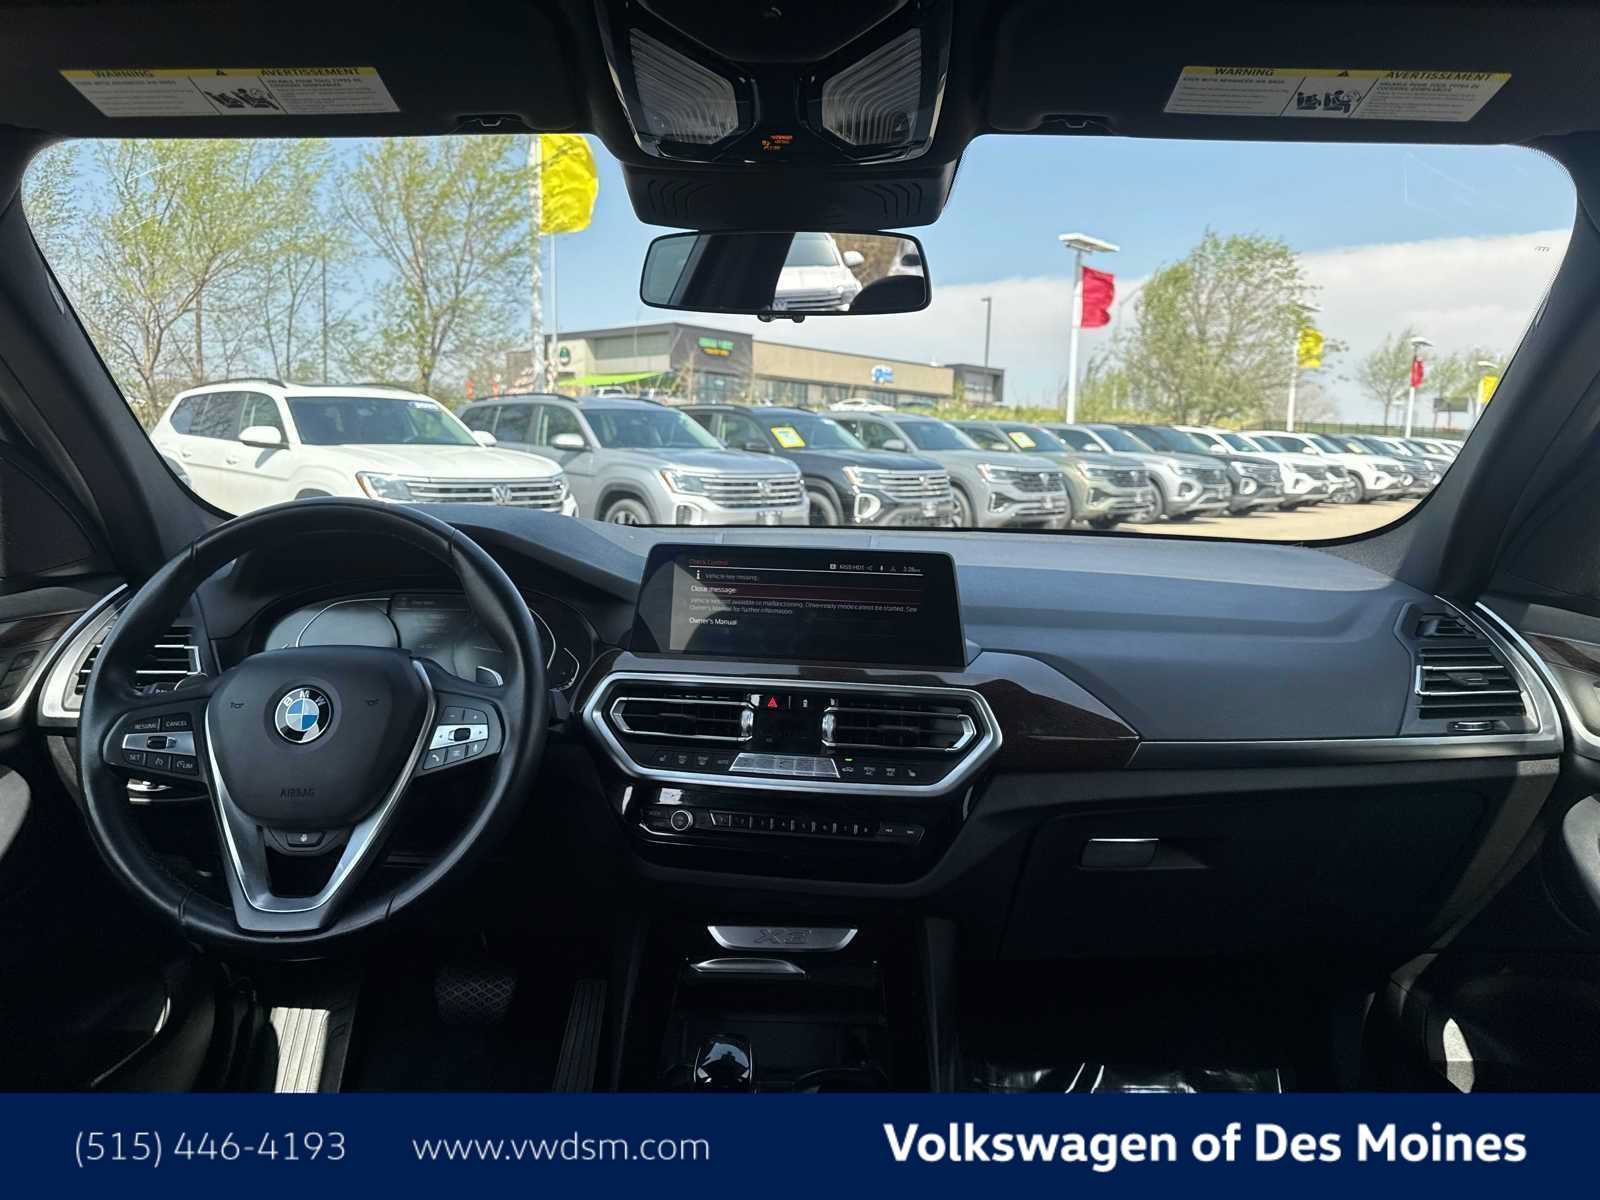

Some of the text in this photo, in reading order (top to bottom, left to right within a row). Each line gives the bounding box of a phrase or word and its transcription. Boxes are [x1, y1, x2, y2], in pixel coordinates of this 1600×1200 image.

[95, 69, 154, 78] WARNING
[260, 68, 361, 77] AVERTISSEMENT
[1214, 67, 1275, 77] WARNING
[1386, 70, 1492, 81] AVERTISSEMENT
[689, 617, 738, 626] Owner's Manual
[283, 690, 327, 708] BMW
[165, 719, 188, 728] CANCEL
[129, 753, 141, 762] SET
[279, 788, 316, 800] AIRBAG
[754, 928, 812, 945] X3
